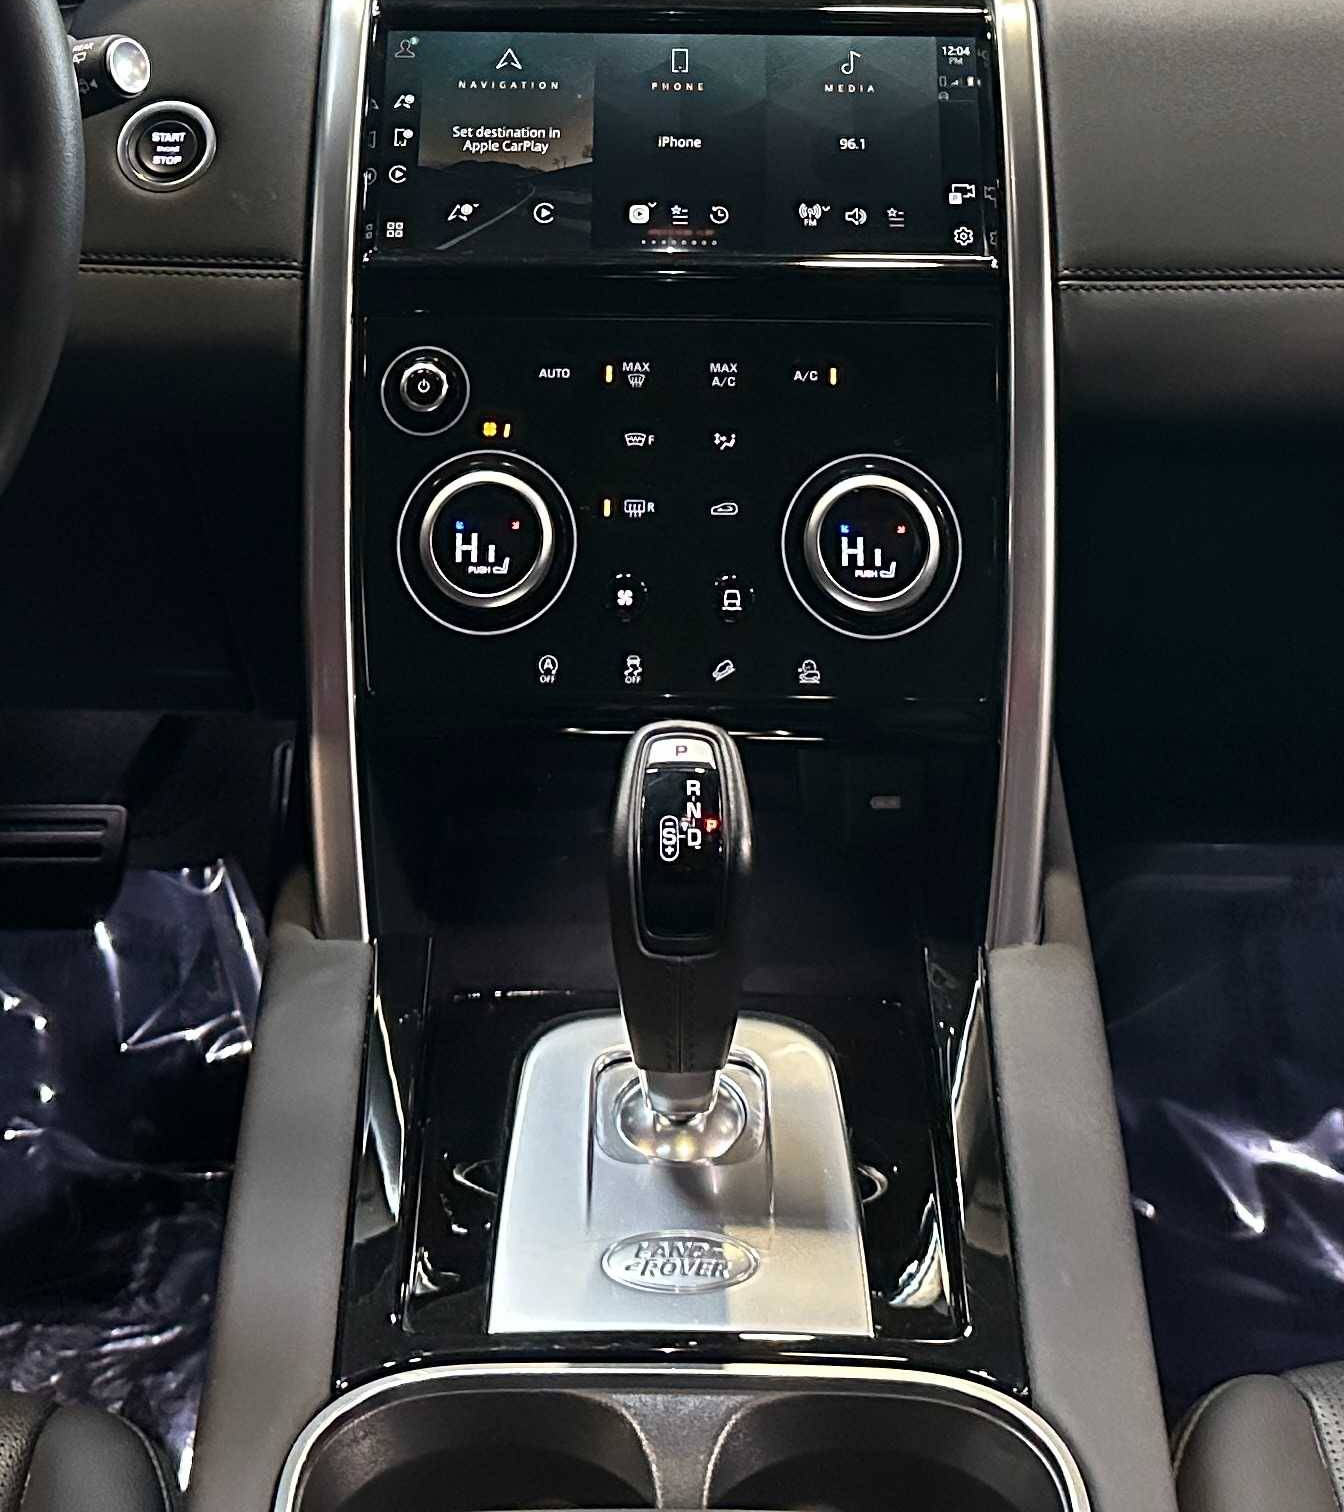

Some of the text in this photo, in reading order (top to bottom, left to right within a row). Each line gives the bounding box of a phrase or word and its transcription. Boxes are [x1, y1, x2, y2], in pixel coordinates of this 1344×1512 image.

[942, 45, 971, 56] 12:04
[458, 80, 559, 90] NAVIGATION
[651, 82, 704, 91] PHONE
[824, 84, 875, 93] MEDIA
[151, 131, 186, 143] START
[452, 125, 561, 139] Set destination in
[463, 139, 549, 155] Apple CarPlay
[658, 135, 702, 148] iPhone
[839, 138, 866, 150] 96.1
[152, 155, 182, 165] STOP
[803, 218, 817, 227] FM
[538, 367, 571, 379] AUTO
[622, 361, 651, 373] MAX
[709, 362, 738, 374] MAX
[711, 376, 736, 387] A/C
[793, 370, 818, 382] A/C
[647, 502, 655, 513] R
[675, 745, 688, 756] P
[686, 779, 701, 796] R
[686, 802, 701, 818] N
[662, 827, 676, 846] S
[687, 828, 702, 847] D
[638, 1257, 731, 1280] ROVER
